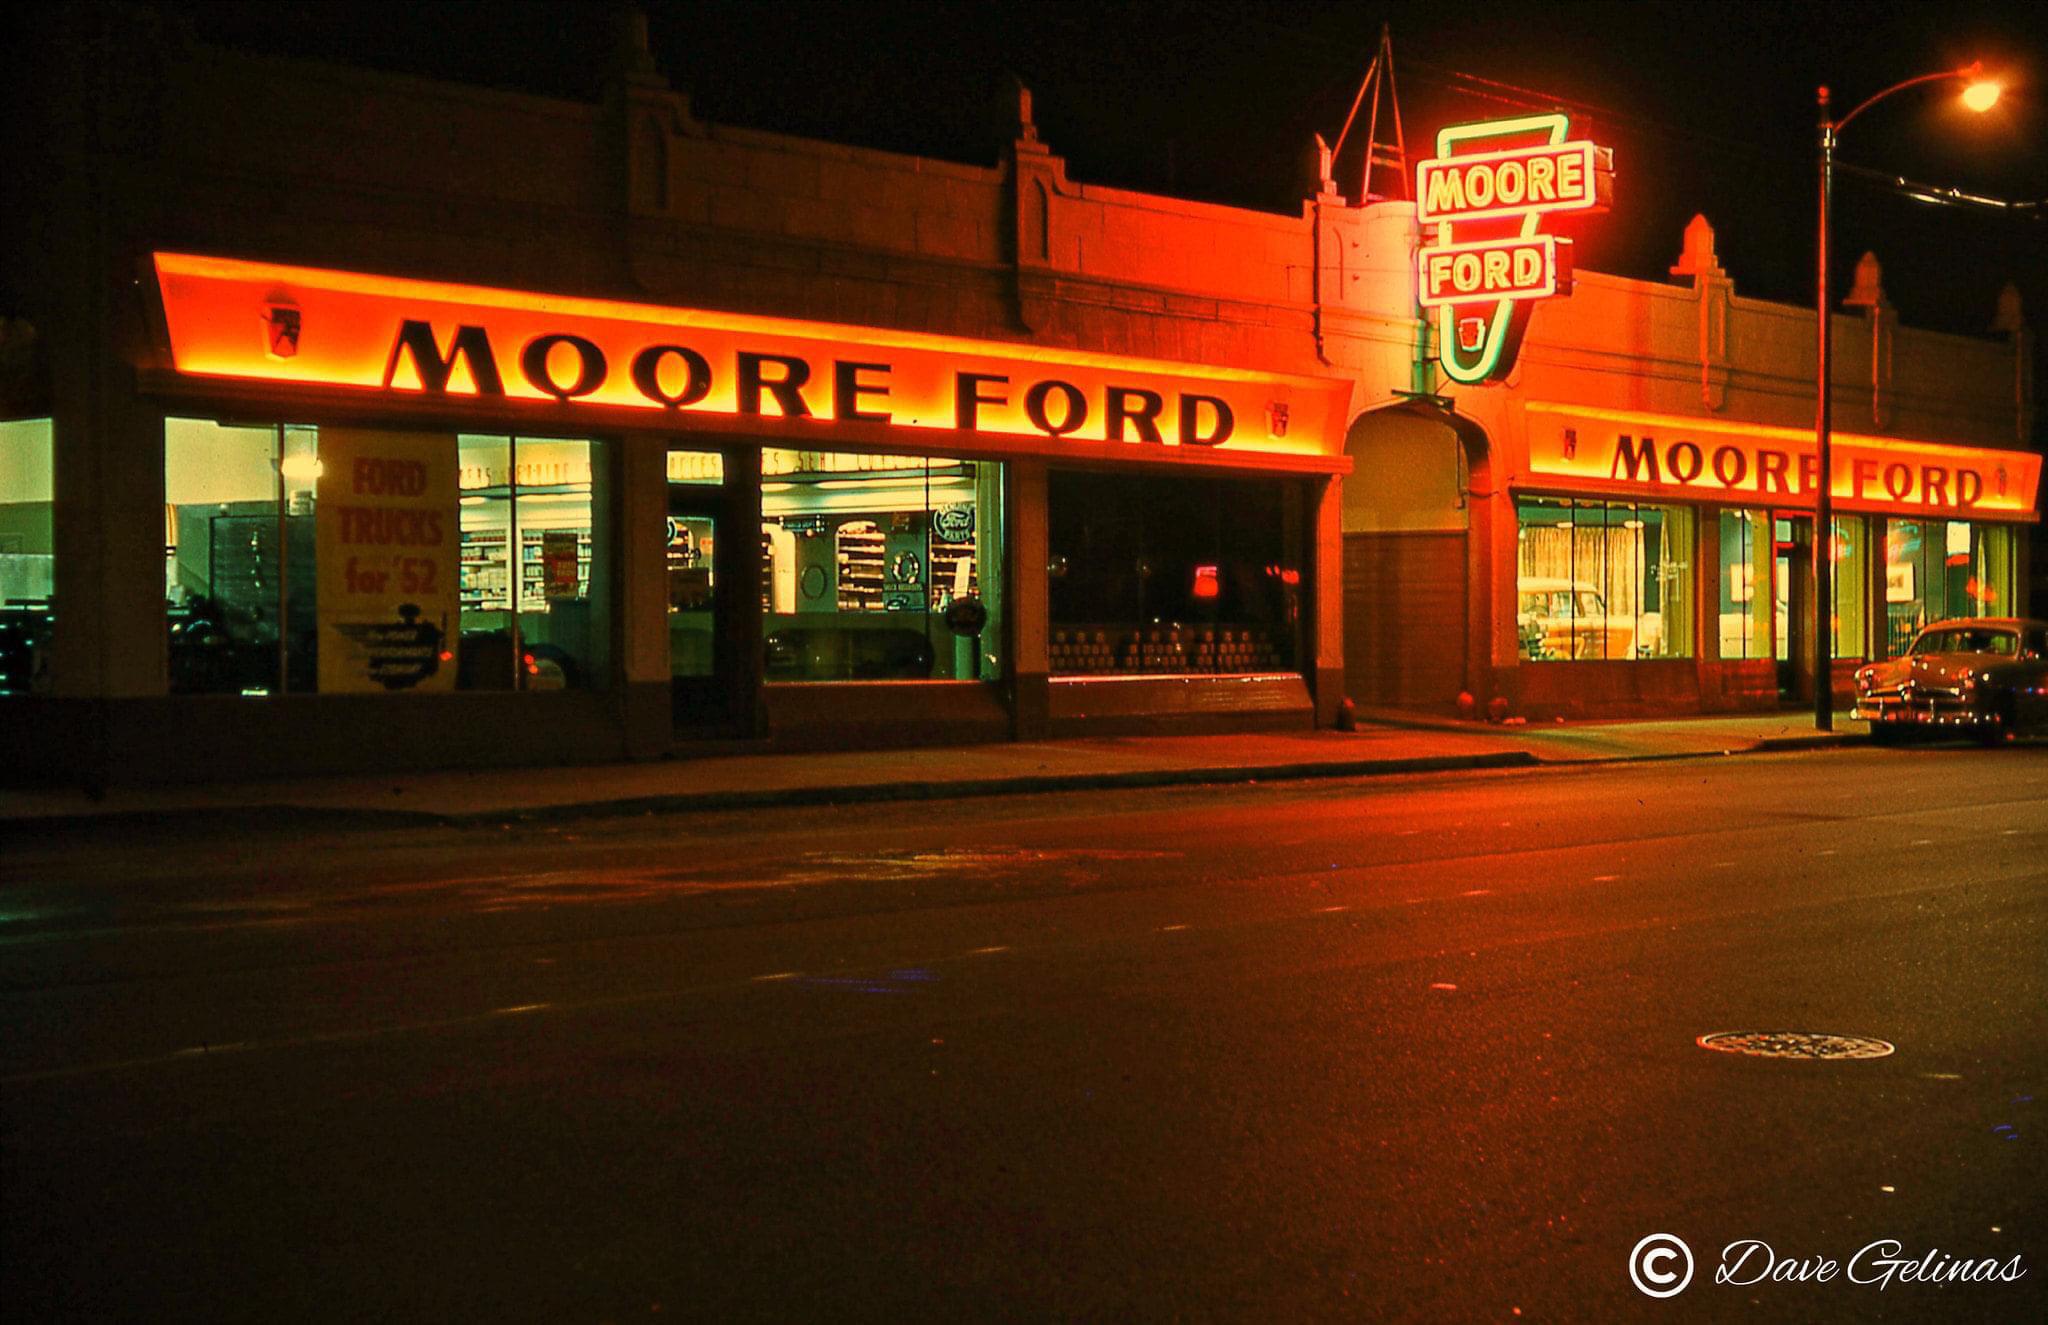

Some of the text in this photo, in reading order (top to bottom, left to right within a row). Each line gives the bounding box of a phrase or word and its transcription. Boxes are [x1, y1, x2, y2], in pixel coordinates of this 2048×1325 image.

[1426, 152, 1584, 213] MOORE
[1430, 247, 1542, 295] FORD
[382, 318, 1236, 447] MOORE FORD
[353, 457, 427, 497] FORD
[1610, 434, 1983, 507] MOORE FORD
[337, 506, 443, 547] TRUCKS
[942, 511, 970, 529] Ford
[346, 556, 389, 594] for
